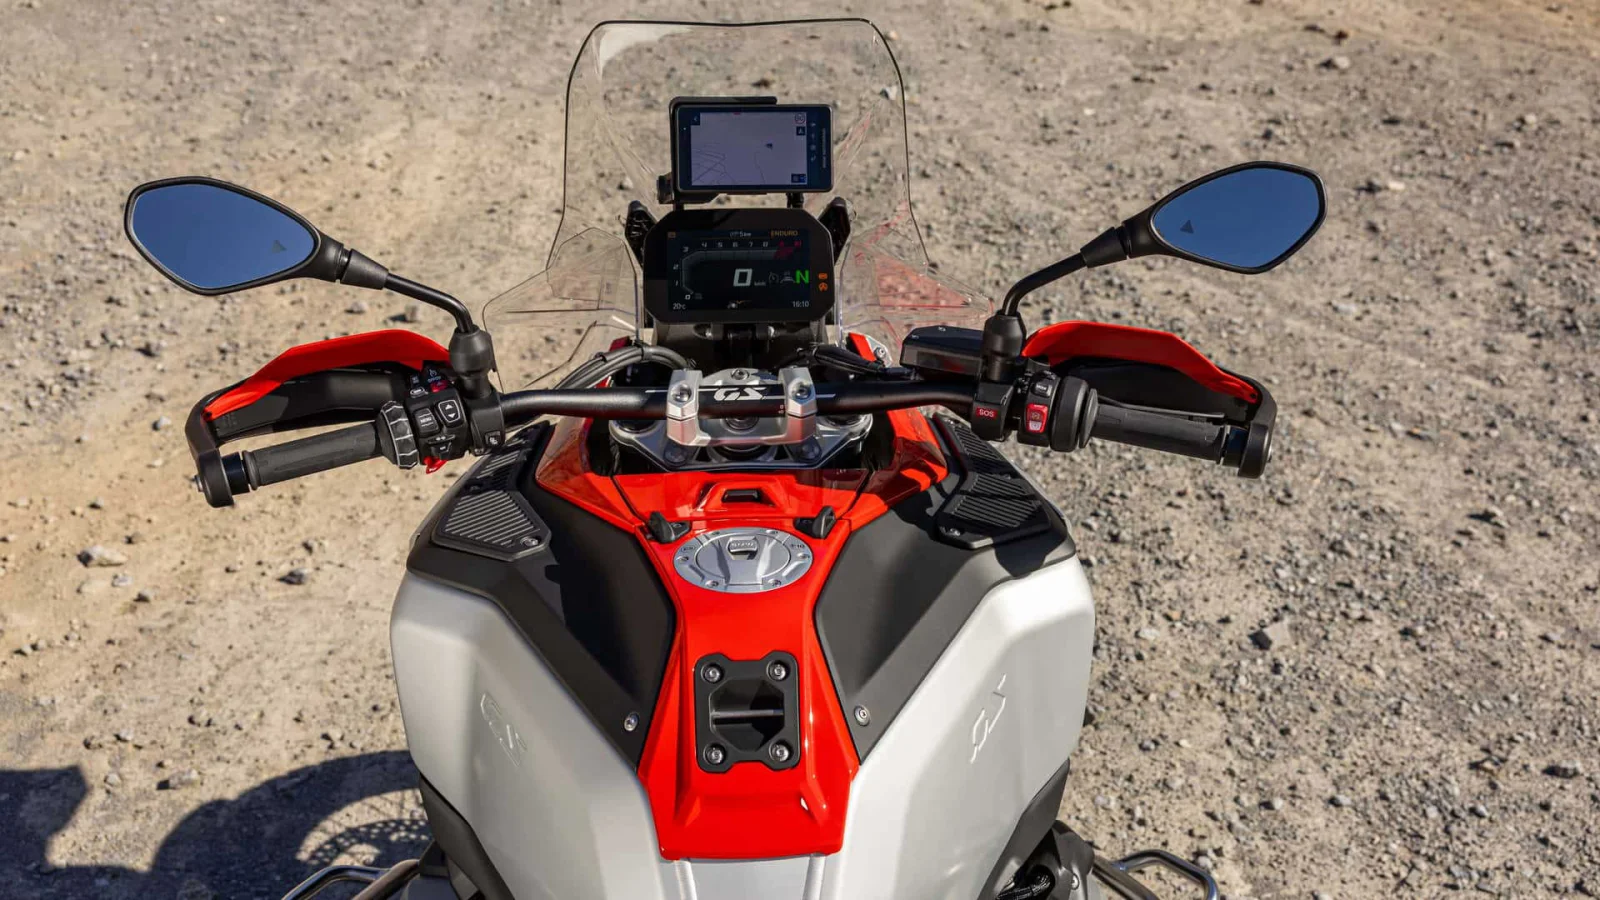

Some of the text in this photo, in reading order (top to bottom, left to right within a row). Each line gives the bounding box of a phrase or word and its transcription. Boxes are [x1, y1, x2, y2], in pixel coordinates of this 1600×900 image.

[733, 268, 753, 287] 0
[796, 269, 810, 285] N
[714, 386, 767, 401] GS
[979, 408, 995, 418] SOS
